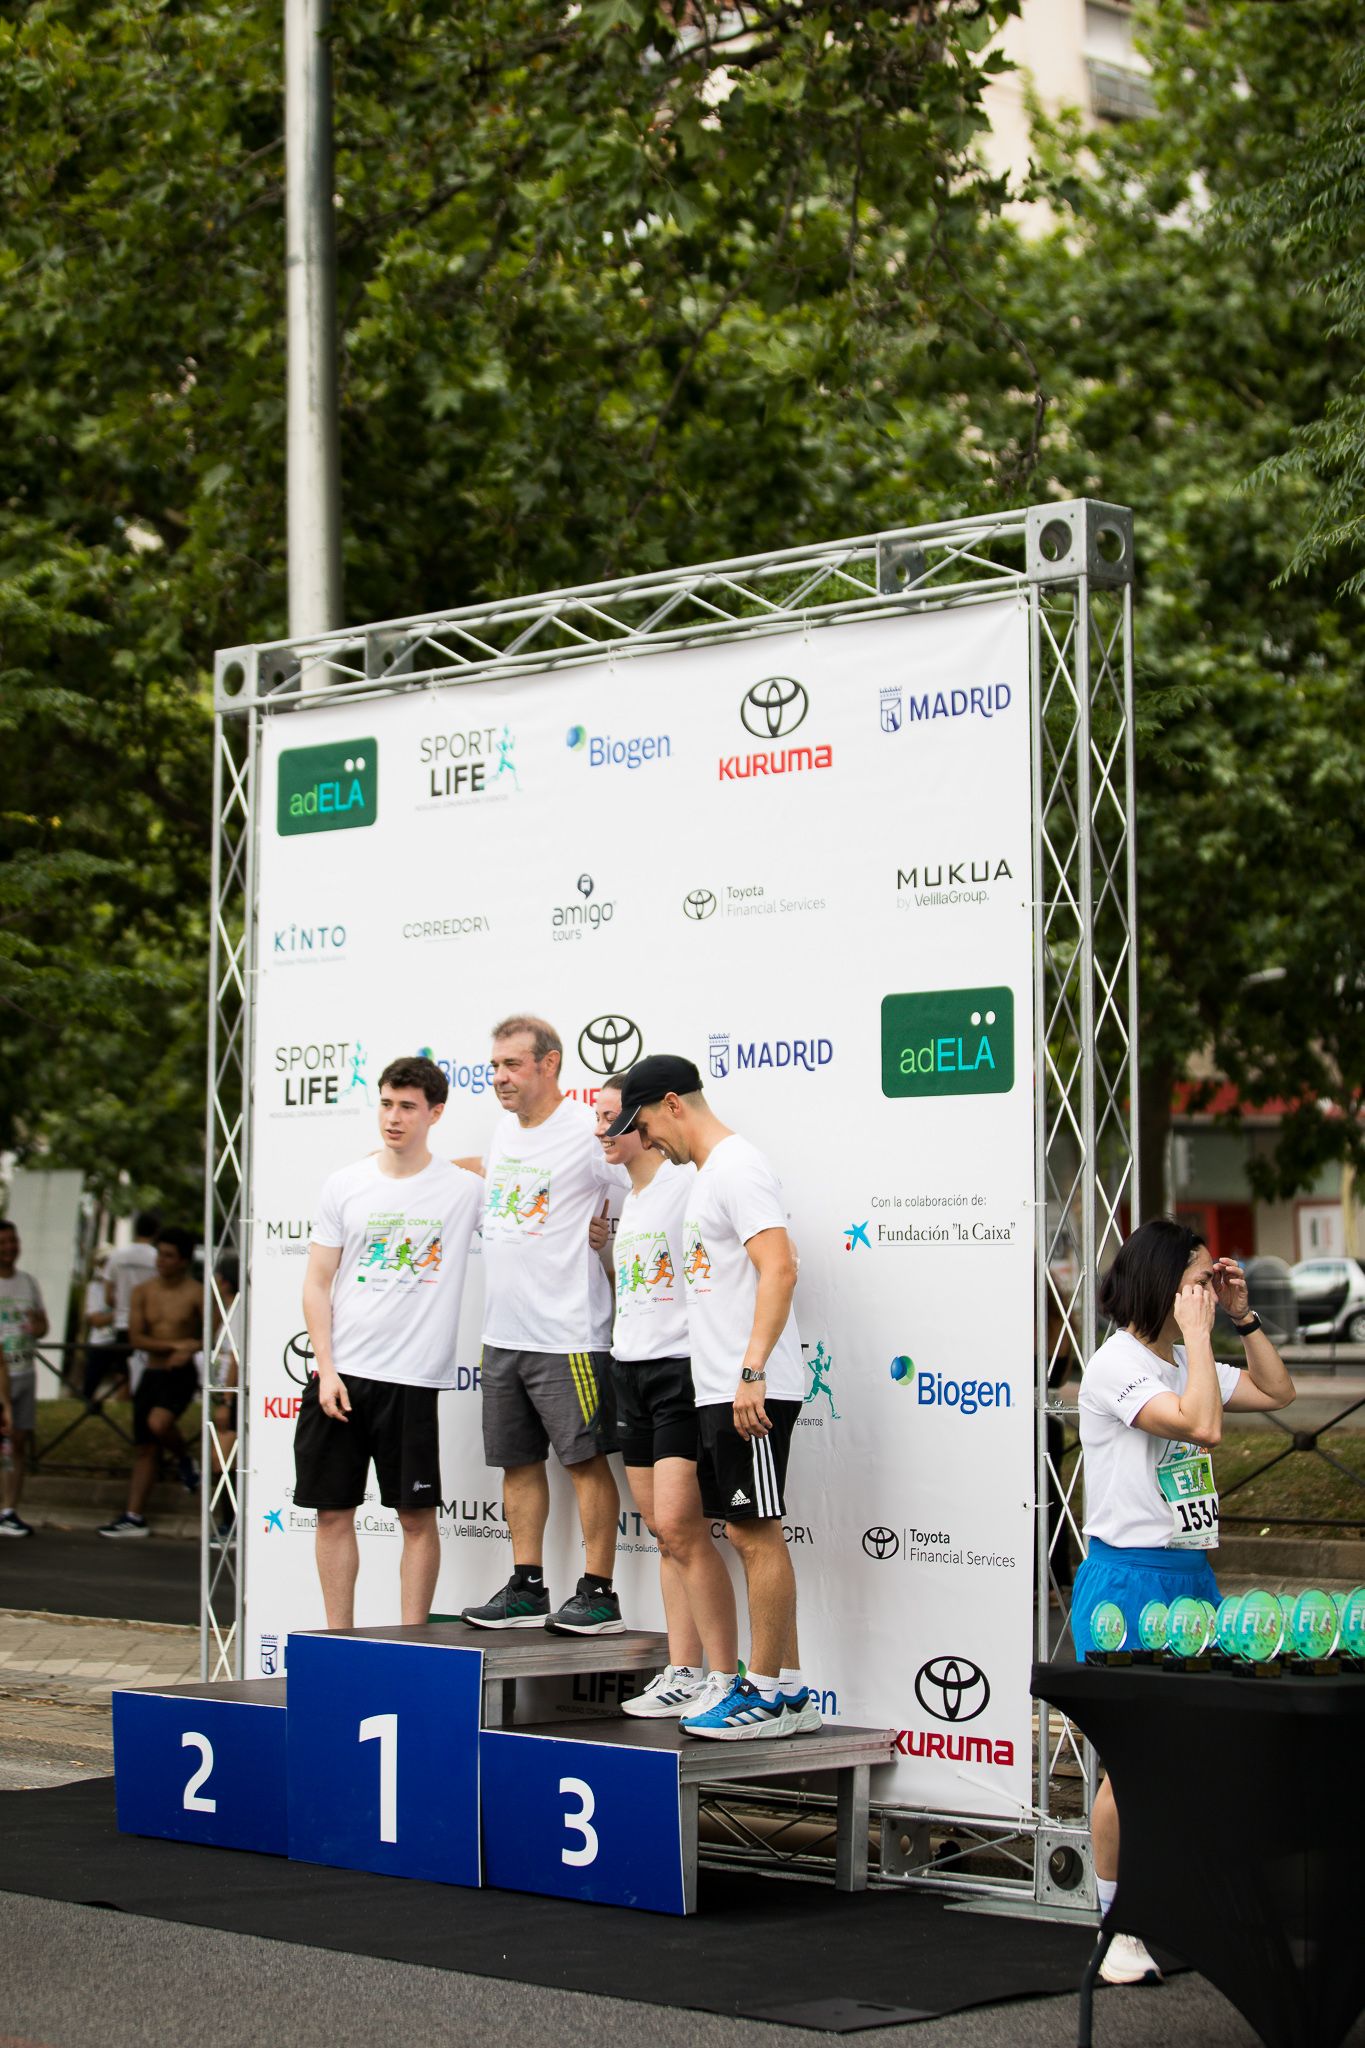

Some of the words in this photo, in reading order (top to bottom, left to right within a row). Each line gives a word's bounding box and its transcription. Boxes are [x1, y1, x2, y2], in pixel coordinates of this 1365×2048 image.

[909, 682, 1012, 722] MADRID
[420, 728, 497, 763] SPORT
[589, 734, 671, 769] Biogen
[431, 763, 485, 797] LIFE
[290, 779, 365, 816] adELA
[897, 859, 1013, 889] MUKUA
[727, 885, 764, 901] Toyota
[727, 899, 777, 917] Financial
[779, 896, 826, 912] Services
[896, 895, 911, 910] by
[552, 902, 614, 930] amigo
[552, 928, 583, 942] tours
[274, 1043, 350, 1072] SPORT
[737, 1038, 834, 1071] MADRID
[900, 1035, 996, 1074] adELA
[285, 1076, 338, 1106] LIFE
[437, 1059, 496, 1093] Bioge
[871, 1196, 891, 1208] Con
[893, 1196, 902, 1207] la
[905, 1194, 969, 1207] colaboración
[971, 1194, 987, 1207] de:
[877, 1224, 950, 1242] Fundación
[917, 1372, 1011, 1415] Biogen
[796, 1418, 823, 1427] EVENTOS
[1176, 1498, 1219, 1533] 1534
[909, 1529, 950, 1547] Toyota
[910, 1547, 963, 1565] Financial
[967, 1551, 1016, 1568] Services
[573, 1673, 635, 1703] LIFE
[181, 1731, 217, 1814] 2
[358, 1713, 398, 1844] 1
[558, 1777, 599, 1868] 3
